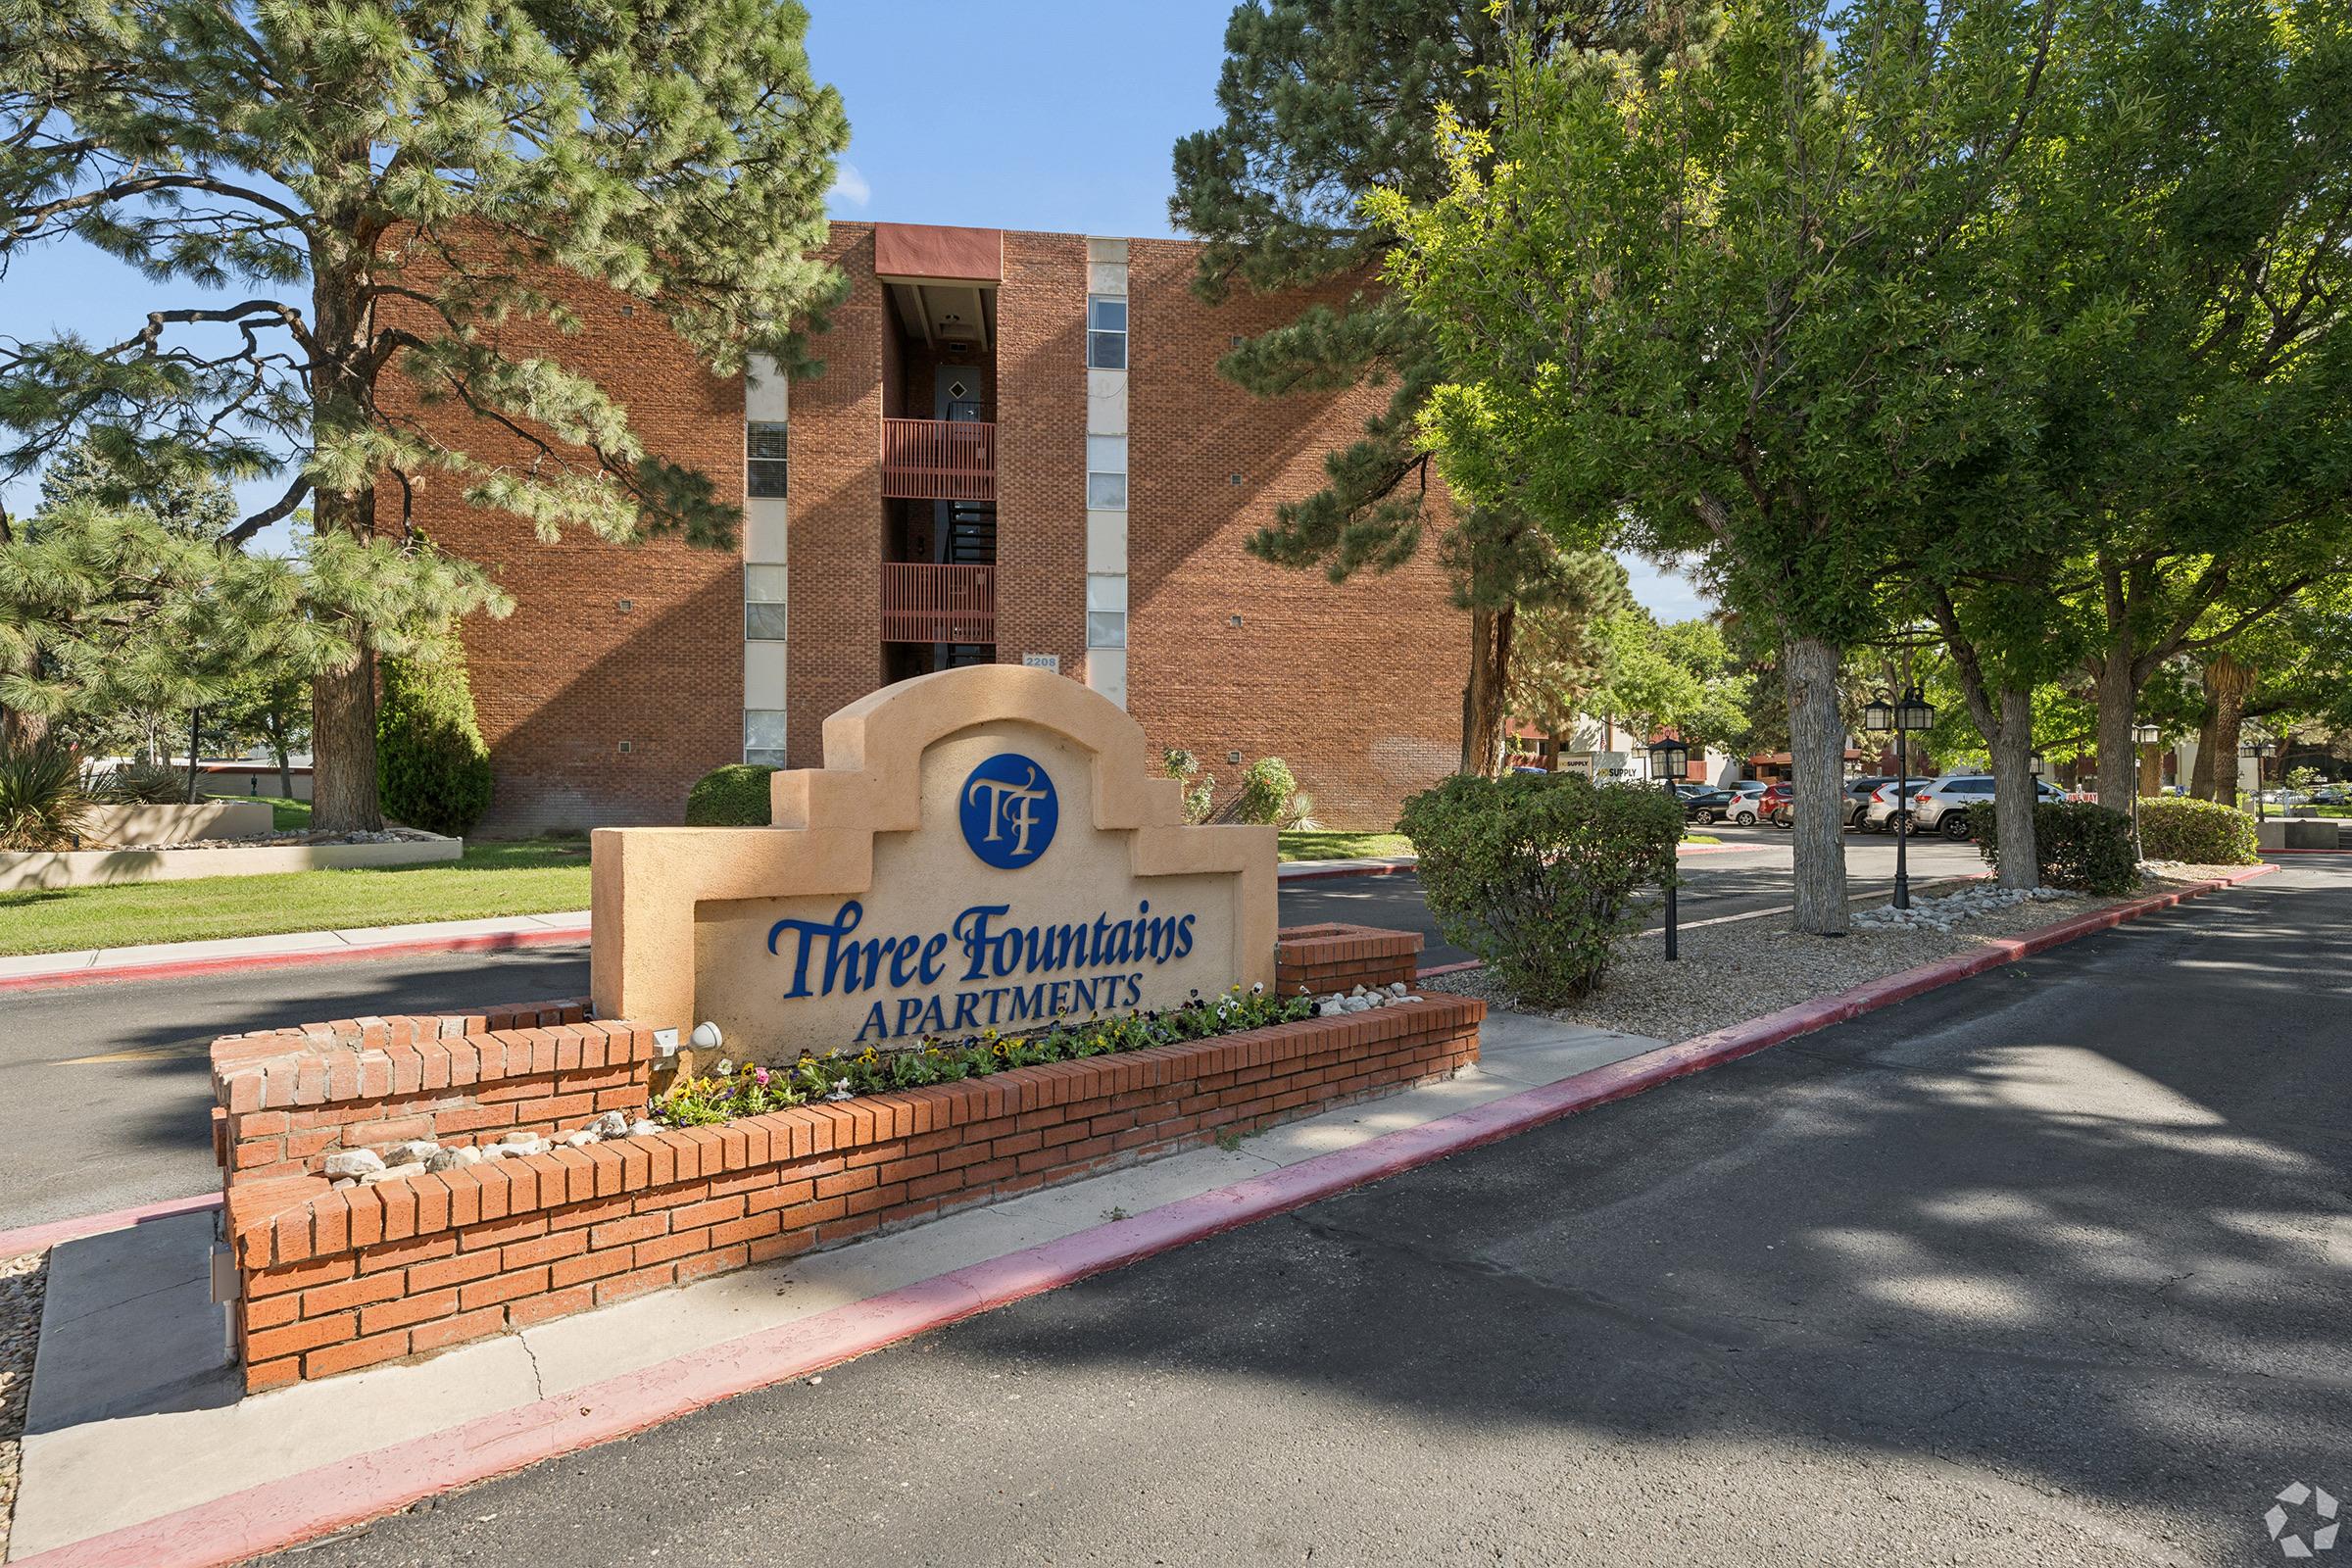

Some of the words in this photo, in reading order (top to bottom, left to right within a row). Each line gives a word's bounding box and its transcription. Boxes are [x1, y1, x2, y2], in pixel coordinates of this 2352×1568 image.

[1026, 658, 1056, 666] 2208
[2082, 793, 2097, 802] WAY
[767, 901, 948, 999] Three
[953, 900, 1197, 981] Fountains
[855, 972, 1143, 1042] APARTMENTS
